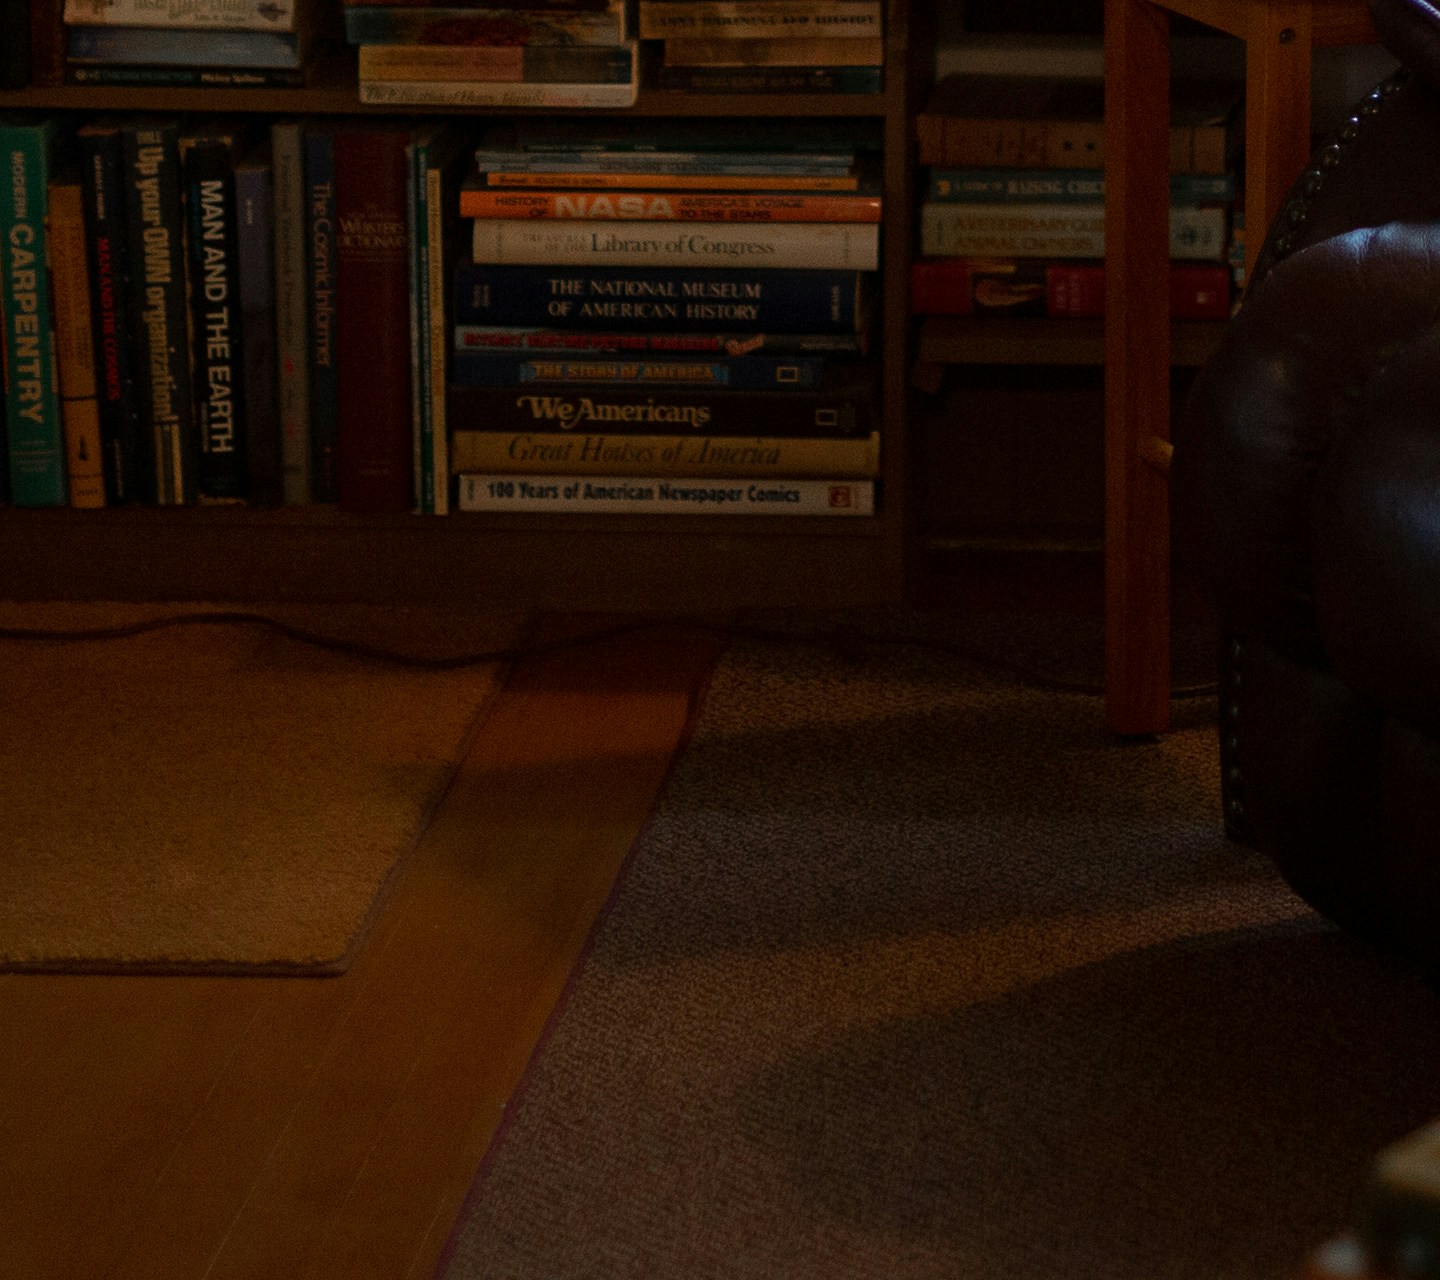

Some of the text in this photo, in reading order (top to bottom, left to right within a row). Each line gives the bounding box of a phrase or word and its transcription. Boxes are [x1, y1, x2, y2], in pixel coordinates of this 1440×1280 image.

[556, 196, 674, 218] NASA
[592, 234, 775, 256] Library of Congress
[549, 279, 761, 298] THE NATIONAL MUSEUM
[200, 180, 233, 454] MAN AND THE EARTH
[549, 303, 759, 321] OF AMERICAN HISTORY
[8, 224, 44, 425] CARPENTRY
[517, 395, 712, 429] We Americans
[489, 483, 800, 504] 100 Years of American Newspaper Comics
